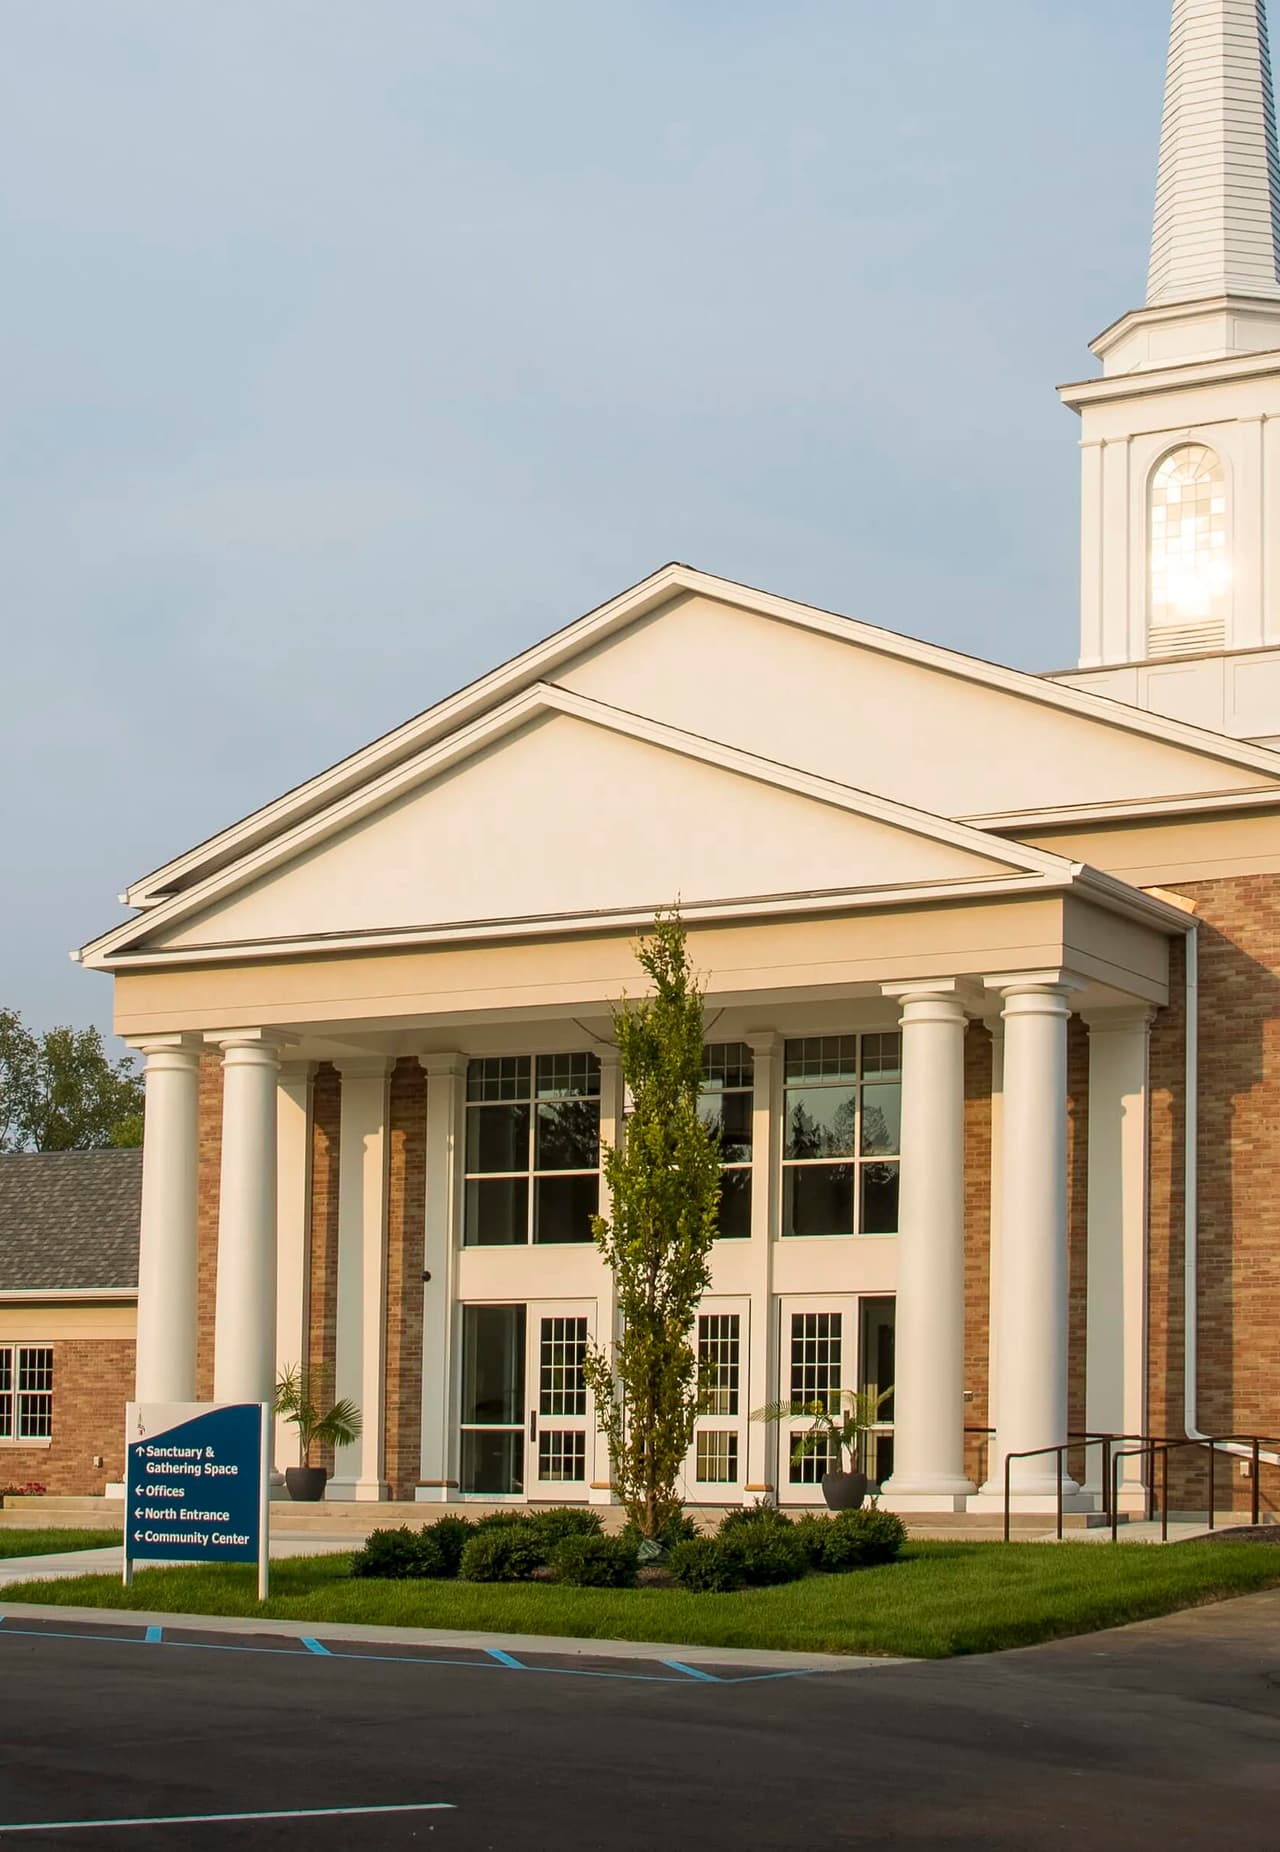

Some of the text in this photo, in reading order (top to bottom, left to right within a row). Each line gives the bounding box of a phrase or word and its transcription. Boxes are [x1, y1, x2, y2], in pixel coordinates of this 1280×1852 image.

[146, 1446, 214, 1459] Sanctuary &
[146, 1462, 238, 1476] Gathering Space
[145, 1485, 185, 1497] Offices
[144, 1507, 230, 1521] North Entrance
[144, 1530, 250, 1546] Community Center
